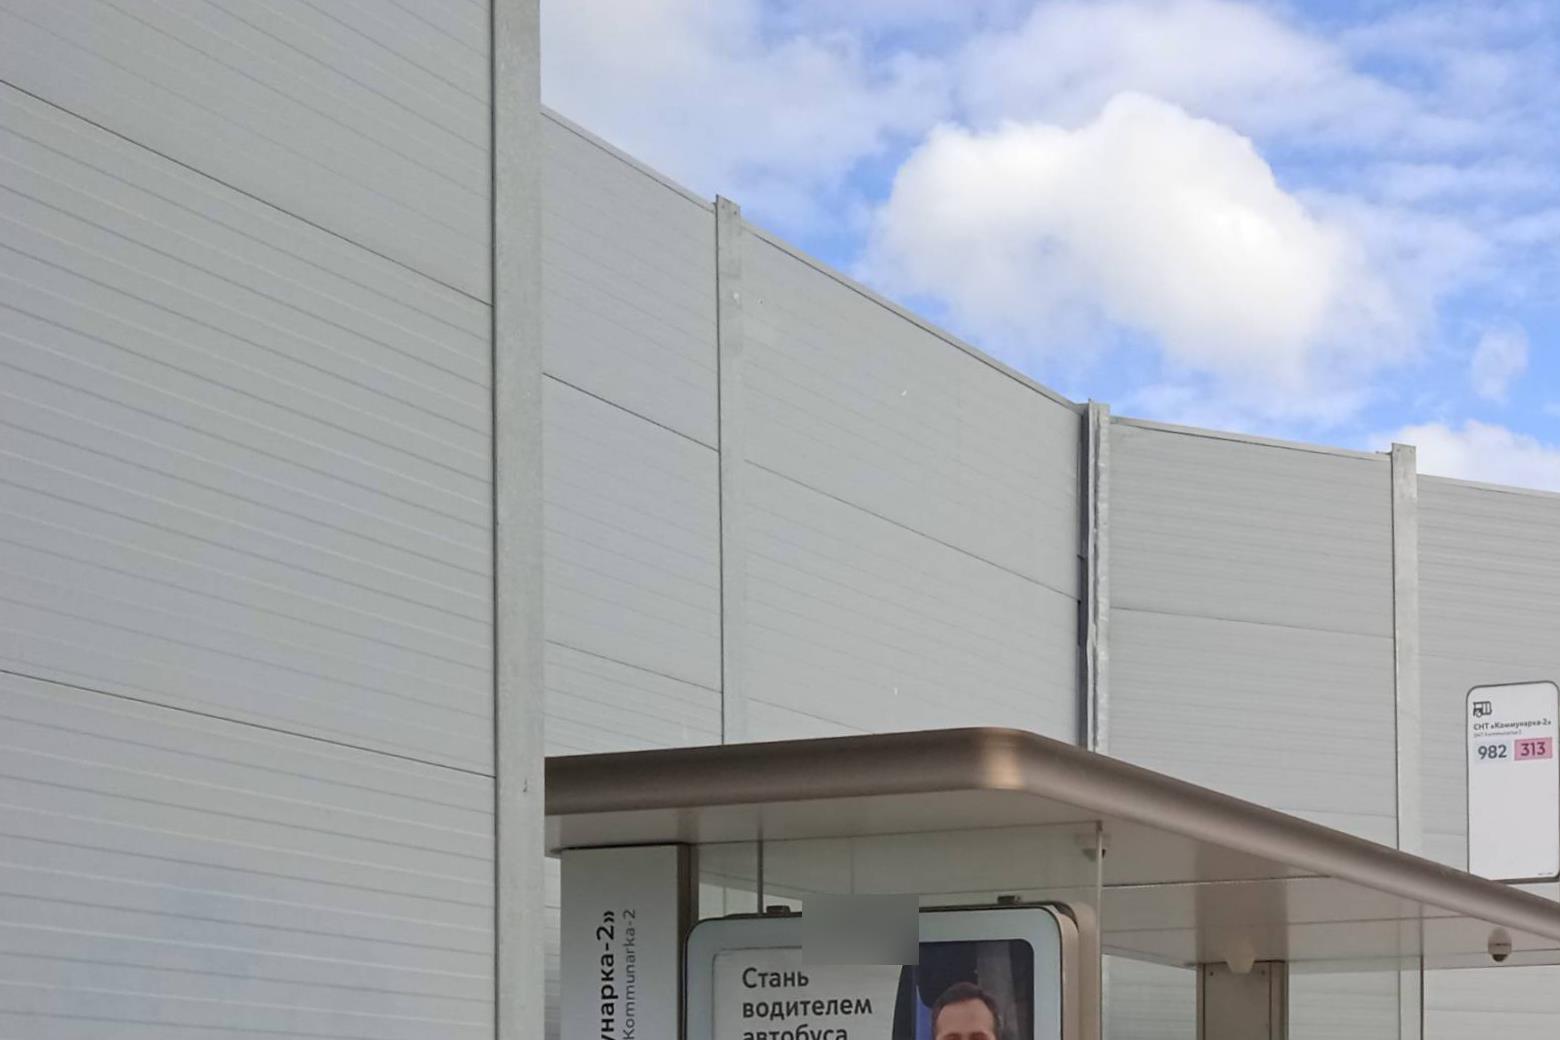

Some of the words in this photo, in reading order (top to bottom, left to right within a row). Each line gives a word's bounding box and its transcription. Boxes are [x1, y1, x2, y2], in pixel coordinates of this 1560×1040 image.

[1478, 744, 1507, 760] 982
[1520, 741, 1546, 757] 313
[622, 909, 636, 1040] Kommunarka-2
[742, 967, 809, 989] Стань
[742, 997, 873, 1020] водителем
